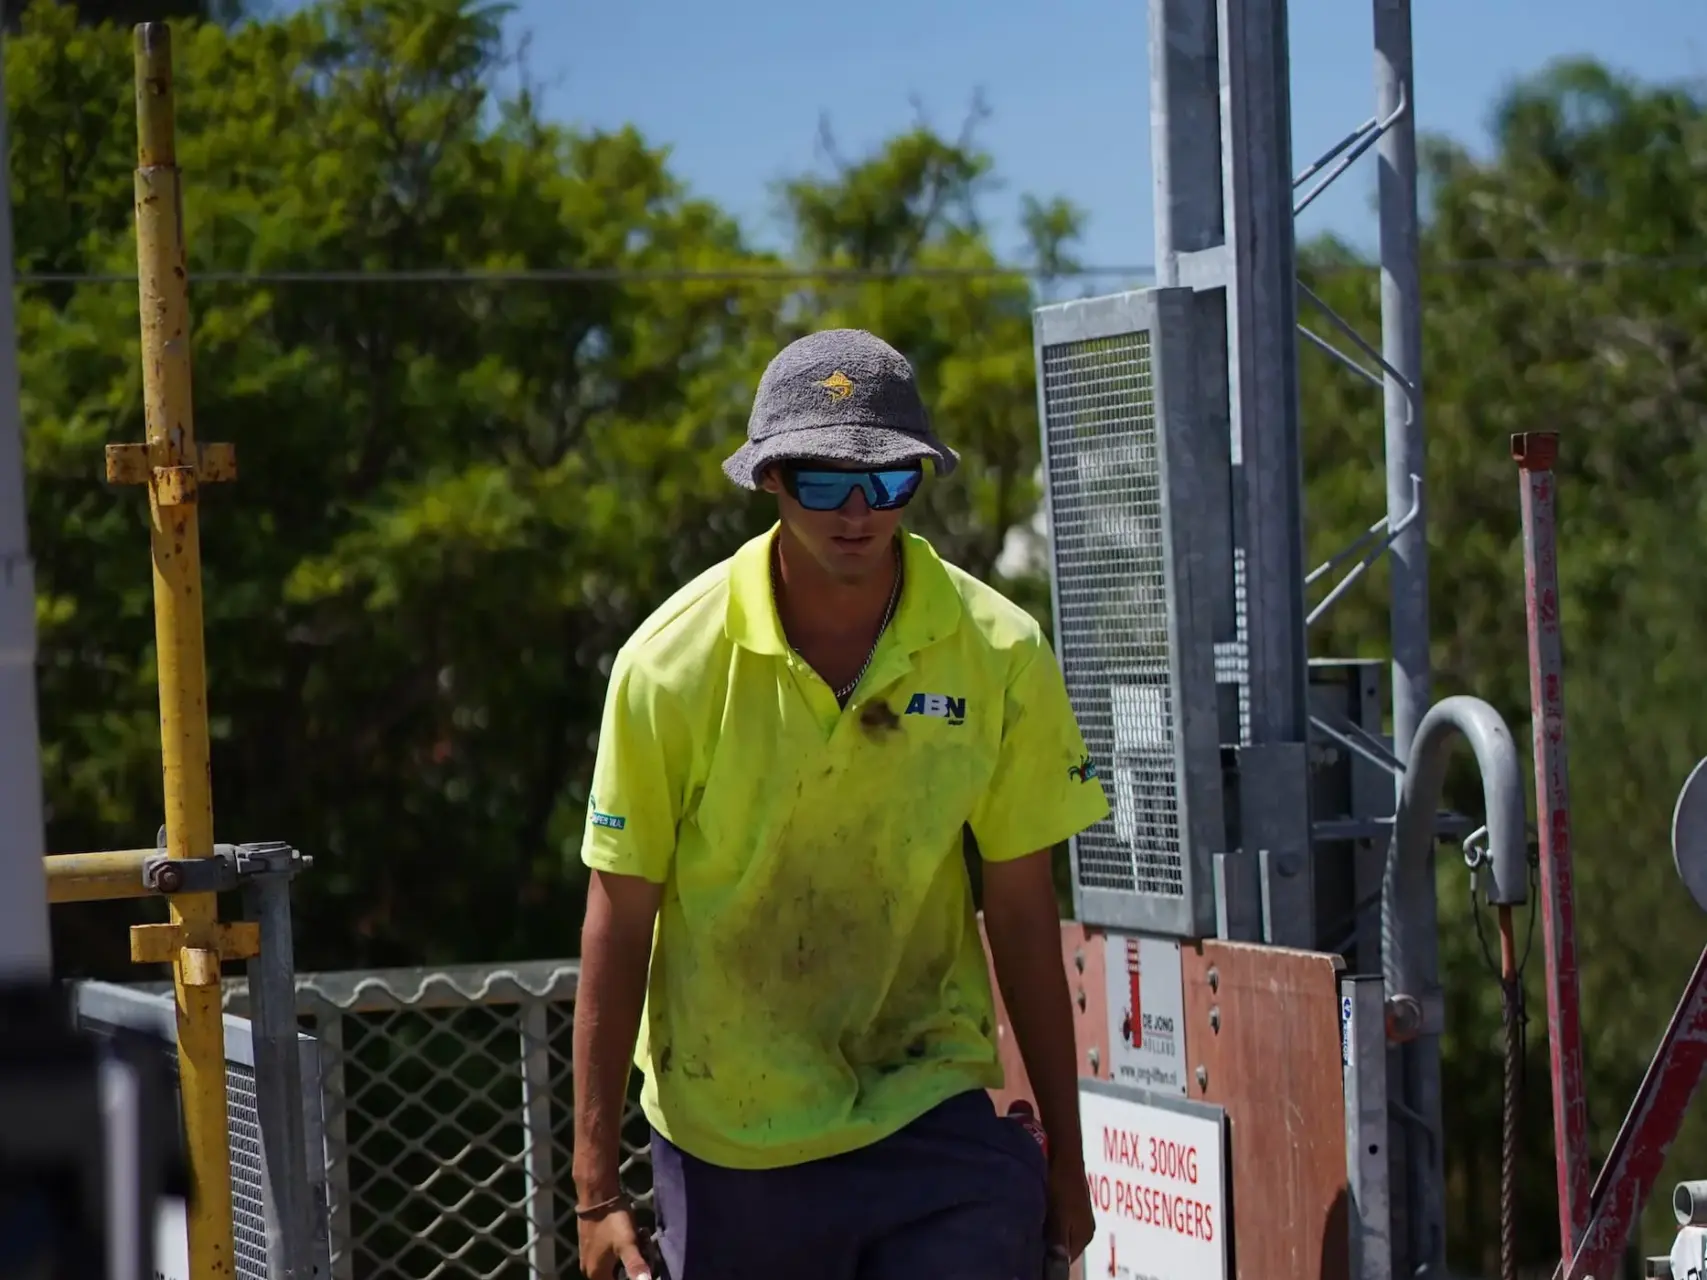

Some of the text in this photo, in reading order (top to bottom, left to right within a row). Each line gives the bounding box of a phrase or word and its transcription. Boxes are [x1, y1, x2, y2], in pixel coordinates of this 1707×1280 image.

[904, 692, 966, 719] ABN
[1142, 1012, 1174, 1033] DE JONG
[1103, 1125, 1198, 1185] MAX. 300KG
[1088, 1171, 1214, 1242] NO PASSENGERS
